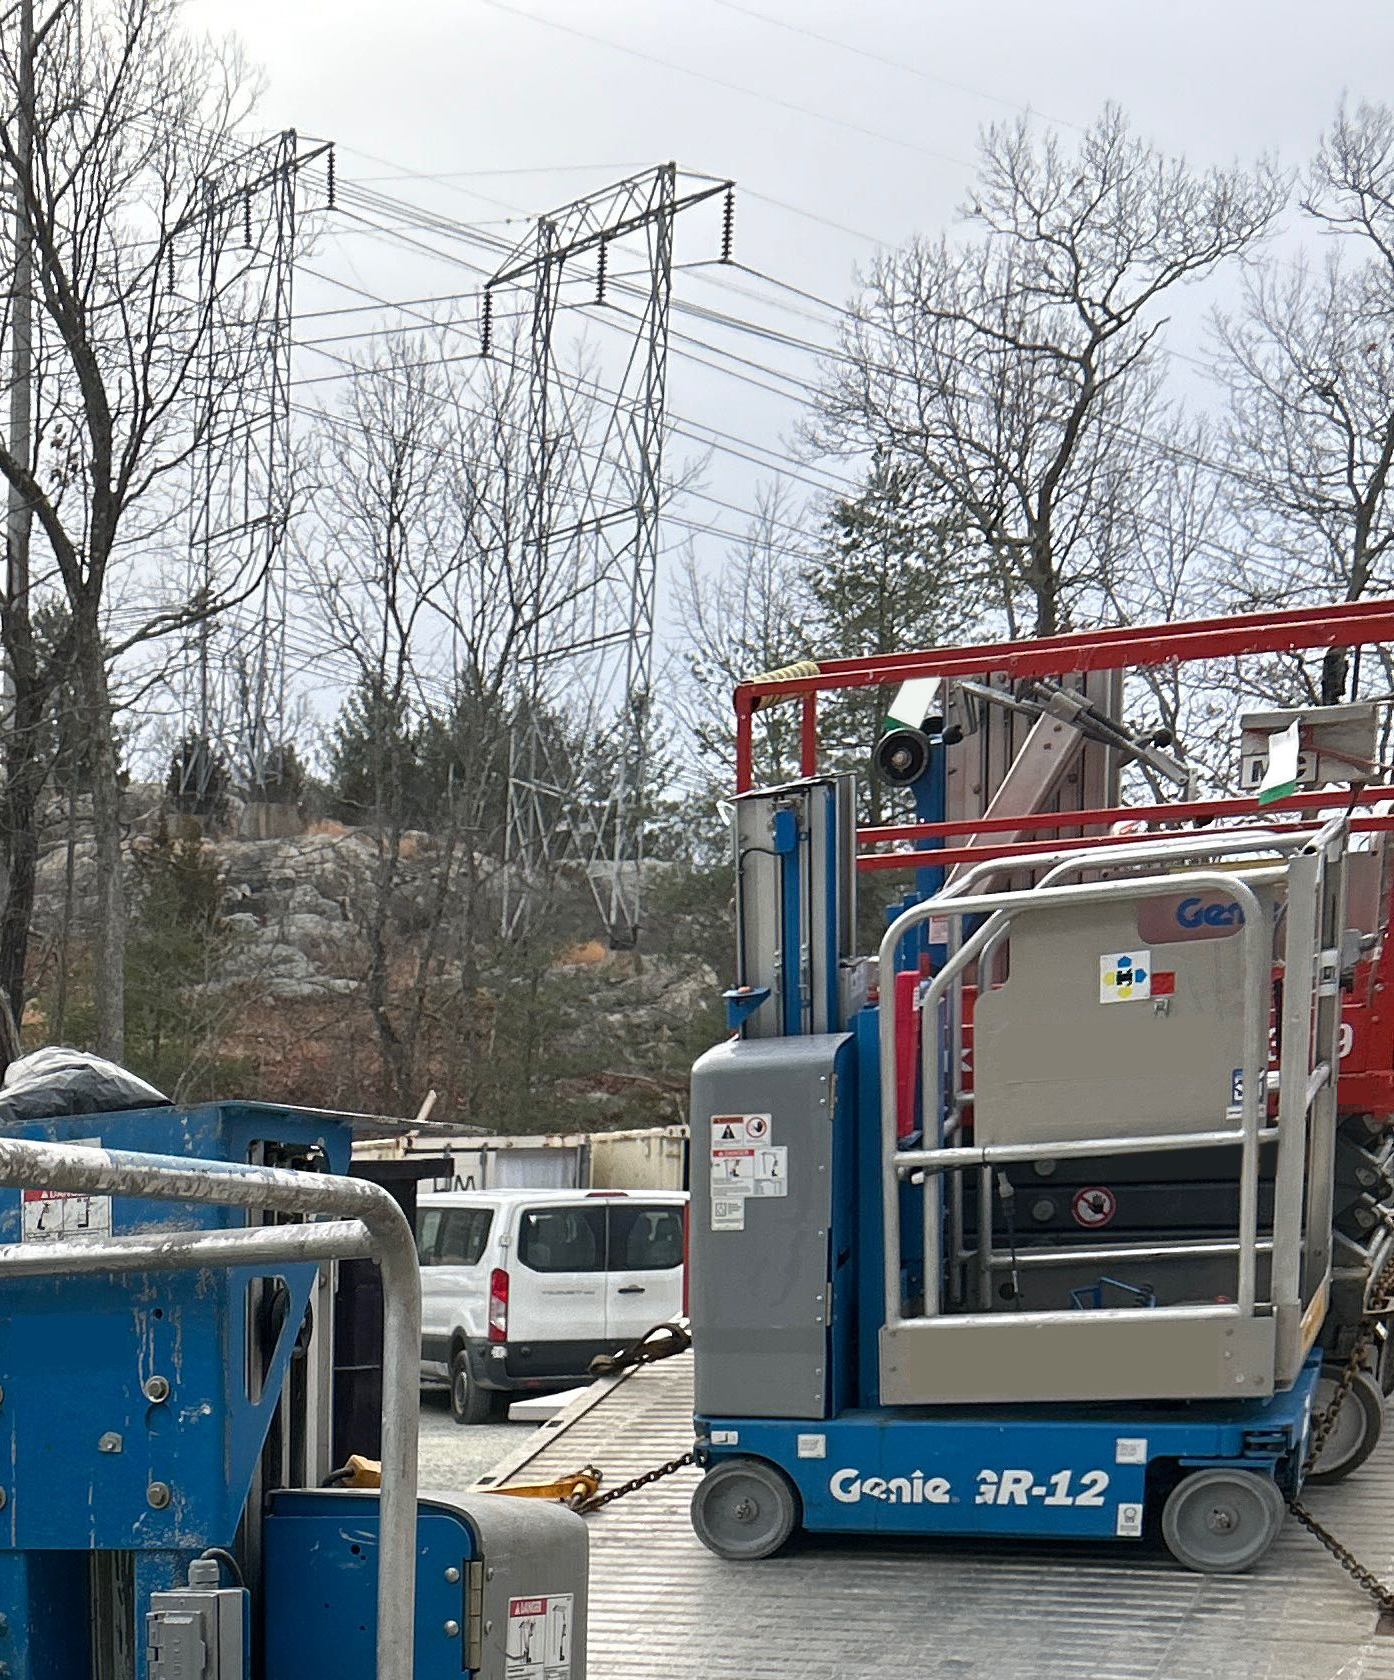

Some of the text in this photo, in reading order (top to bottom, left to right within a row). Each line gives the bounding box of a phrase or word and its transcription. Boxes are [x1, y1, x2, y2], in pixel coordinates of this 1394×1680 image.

[1176, 897, 1246, 929] Gen
[829, 1468, 1111, 1507] Genie GR-12
